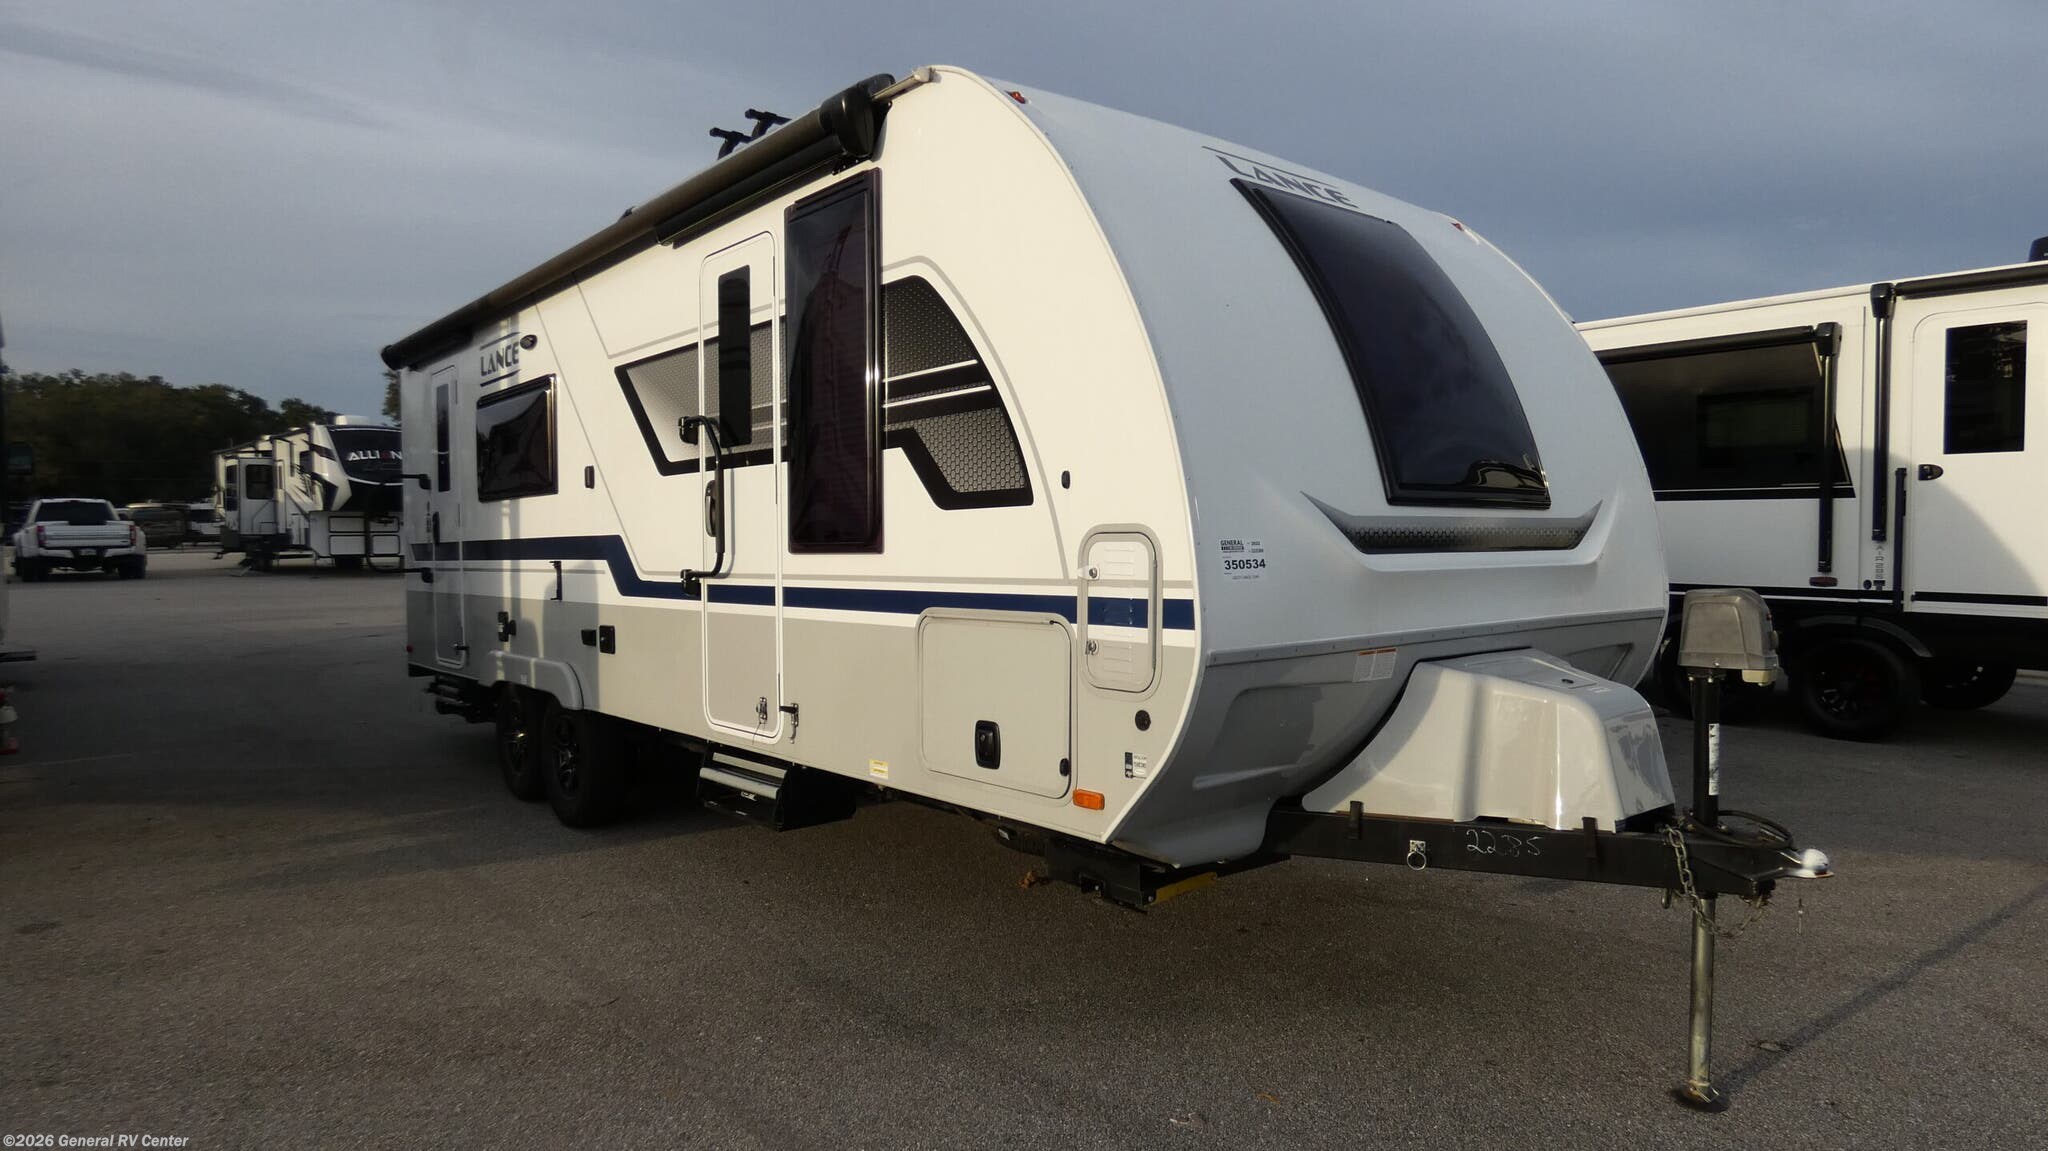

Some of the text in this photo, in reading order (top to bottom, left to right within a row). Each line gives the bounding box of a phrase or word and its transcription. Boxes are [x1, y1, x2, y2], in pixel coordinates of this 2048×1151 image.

[1216, 155, 1359, 208] LANCE
[480, 342, 520, 376] LANCE
[1224, 558, 1266, 570] 350534
